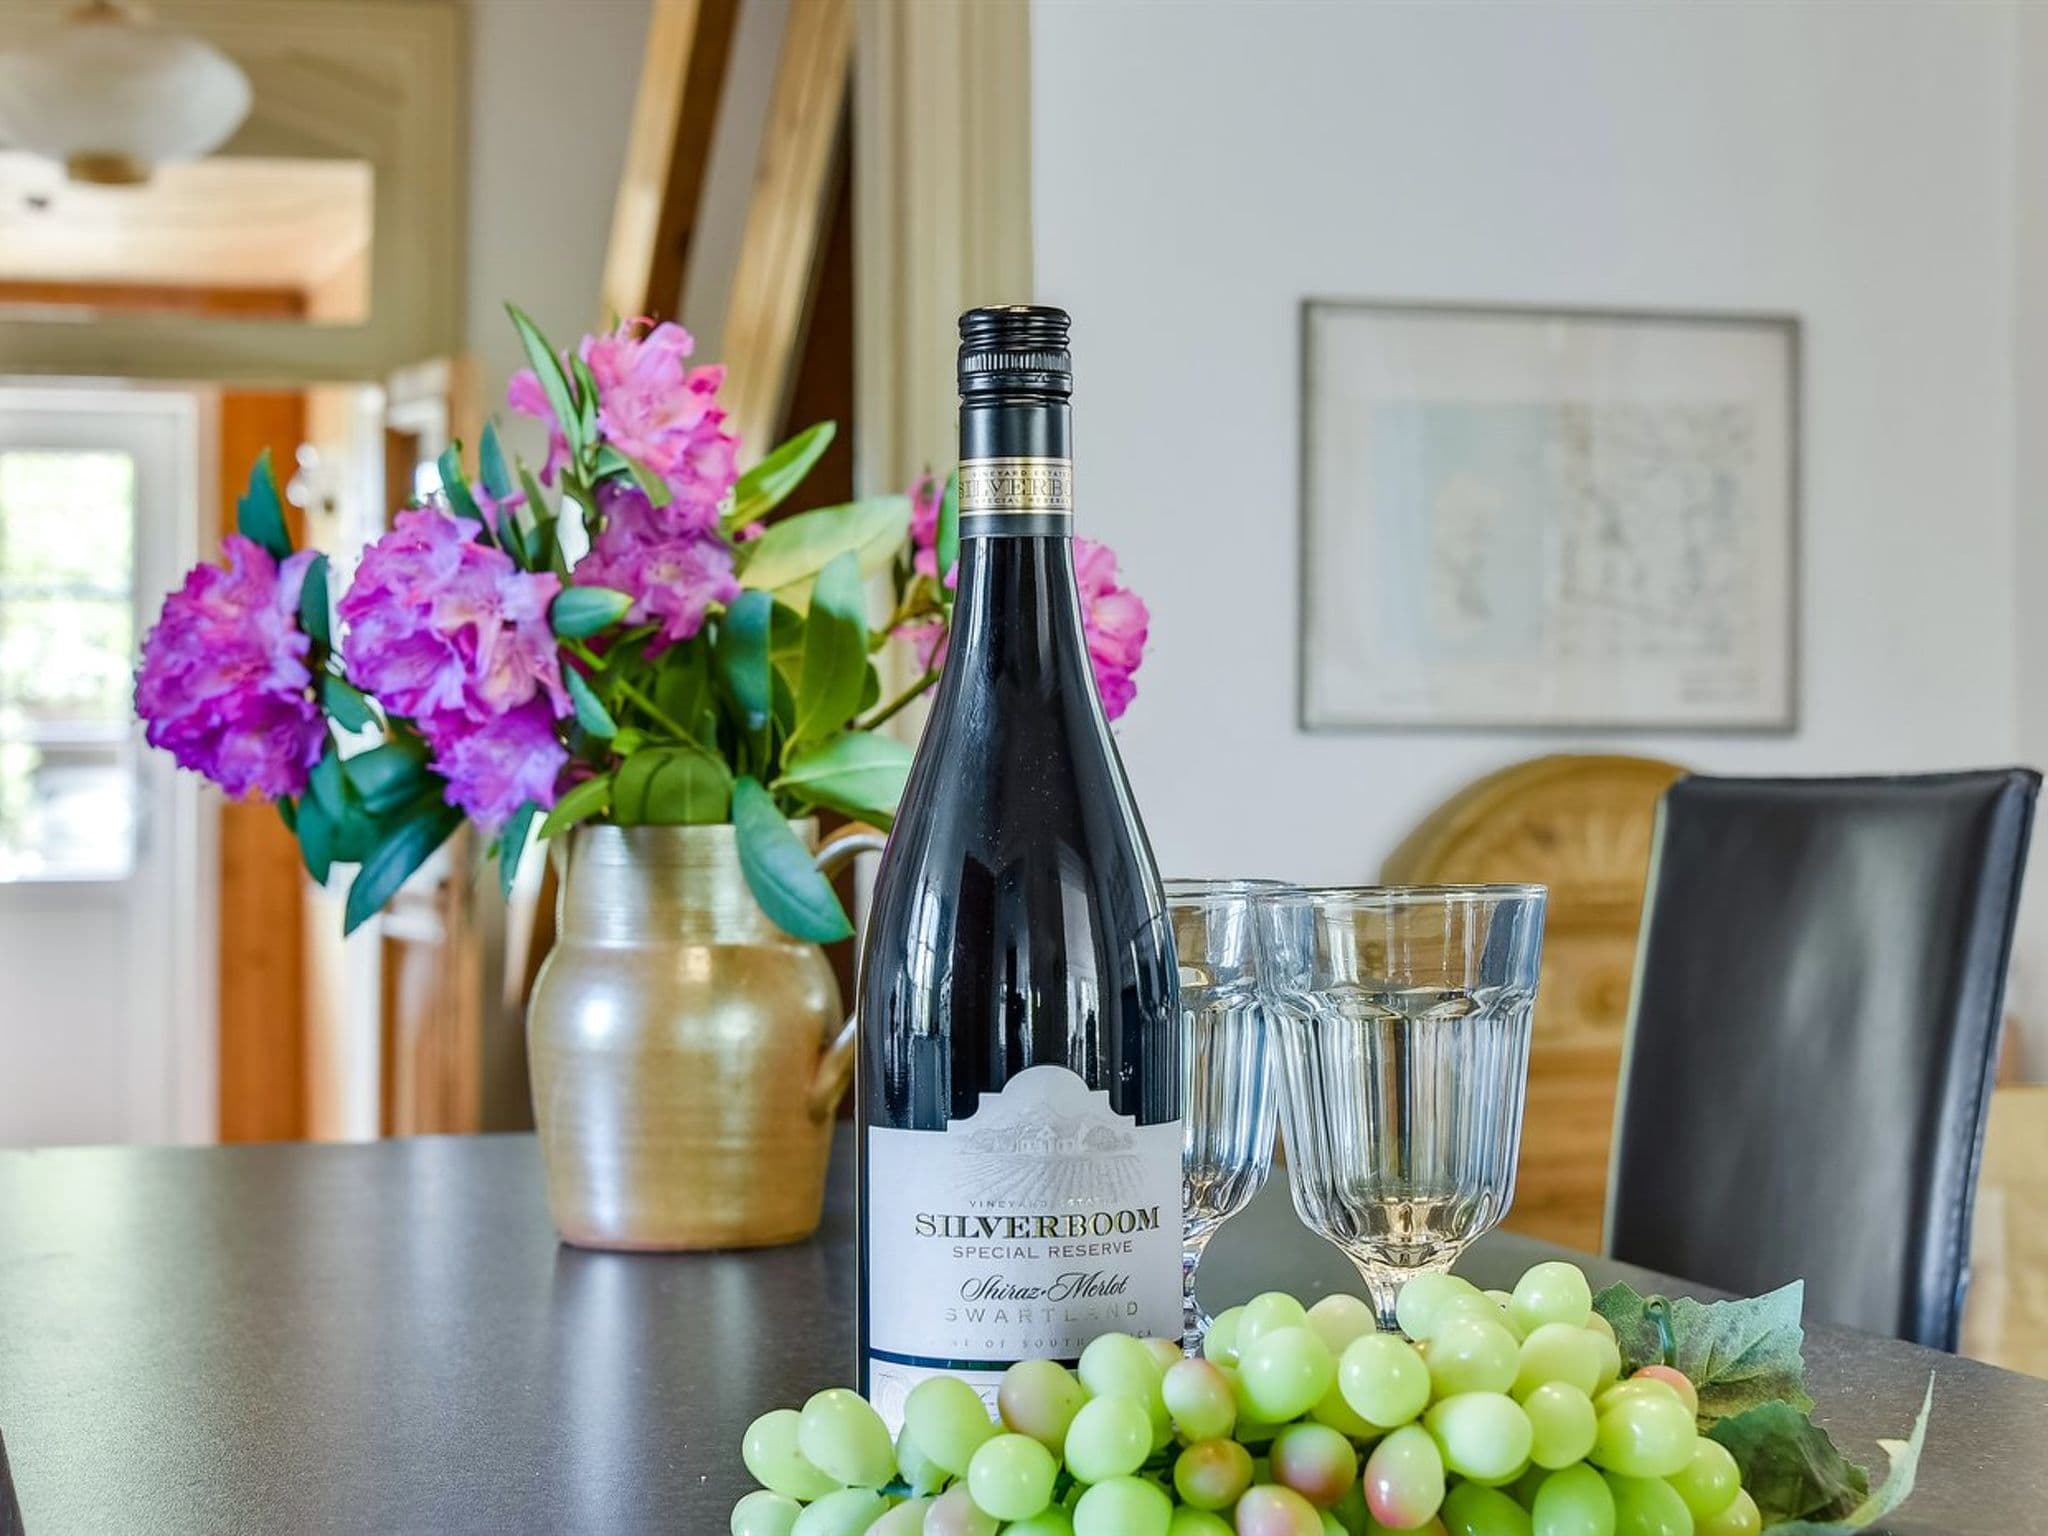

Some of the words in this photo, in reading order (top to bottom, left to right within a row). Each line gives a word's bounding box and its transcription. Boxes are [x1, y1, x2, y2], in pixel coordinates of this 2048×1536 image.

[969, 1199, 1047, 1209] VINEYARD
[915, 1206, 1160, 1239] SILVERBOOM
[952, 1245, 1040, 1260] SPECIAL
[1047, 1240, 1133, 1258] RESERVE
[945, 1302, 1138, 1324] SWARTLAND
